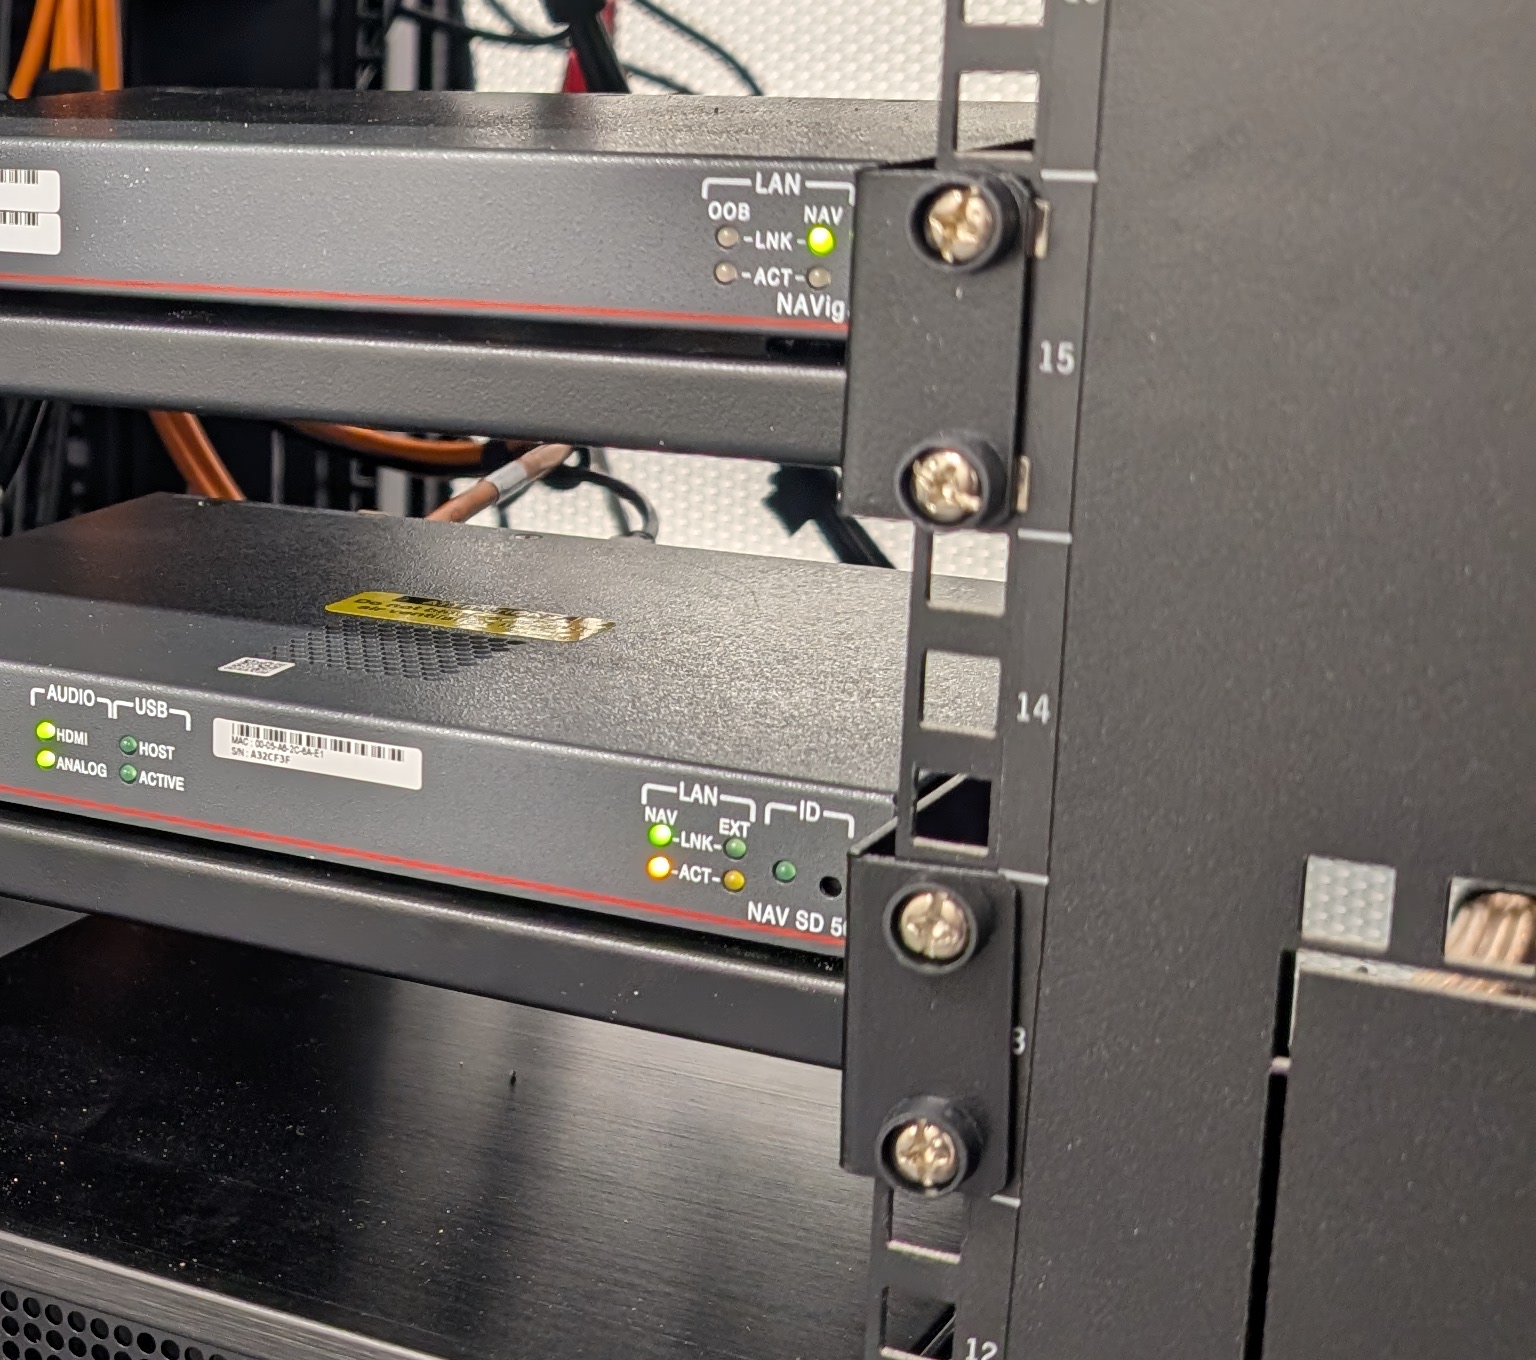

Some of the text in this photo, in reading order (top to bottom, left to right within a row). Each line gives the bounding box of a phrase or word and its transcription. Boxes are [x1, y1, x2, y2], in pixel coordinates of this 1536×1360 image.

[755, 171, 801, 196] LAN
[708, 201, 751, 221] OOB
[804, 205, 843, 226] NAV
[755, 230, 793, 251] LNK
[753, 267, 793, 287] ACT
[777, 291, 850, 324] NAVig
[1038, 340, 1076, 377] 15
[46, 684, 96, 708] AUDIO
[135, 696, 168, 719] USB
[1016, 691, 1051, 724] 14
[56, 727, 89, 746] HDMI
[232, 736, 249, 746] MAC
[138, 740, 175, 761] HOST
[56, 756, 108, 779] ANALOG
[138, 770, 185, 792] ACTIVE
[679, 781, 718, 806] LAN
[645, 806, 678, 825] NAV
[800, 800, 821, 822] ID
[719, 818, 750, 838] EXT
[681, 830, 713, 852] LNK
[679, 864, 712, 884] ACT
[748, 900, 846, 937] NAV SD 5
